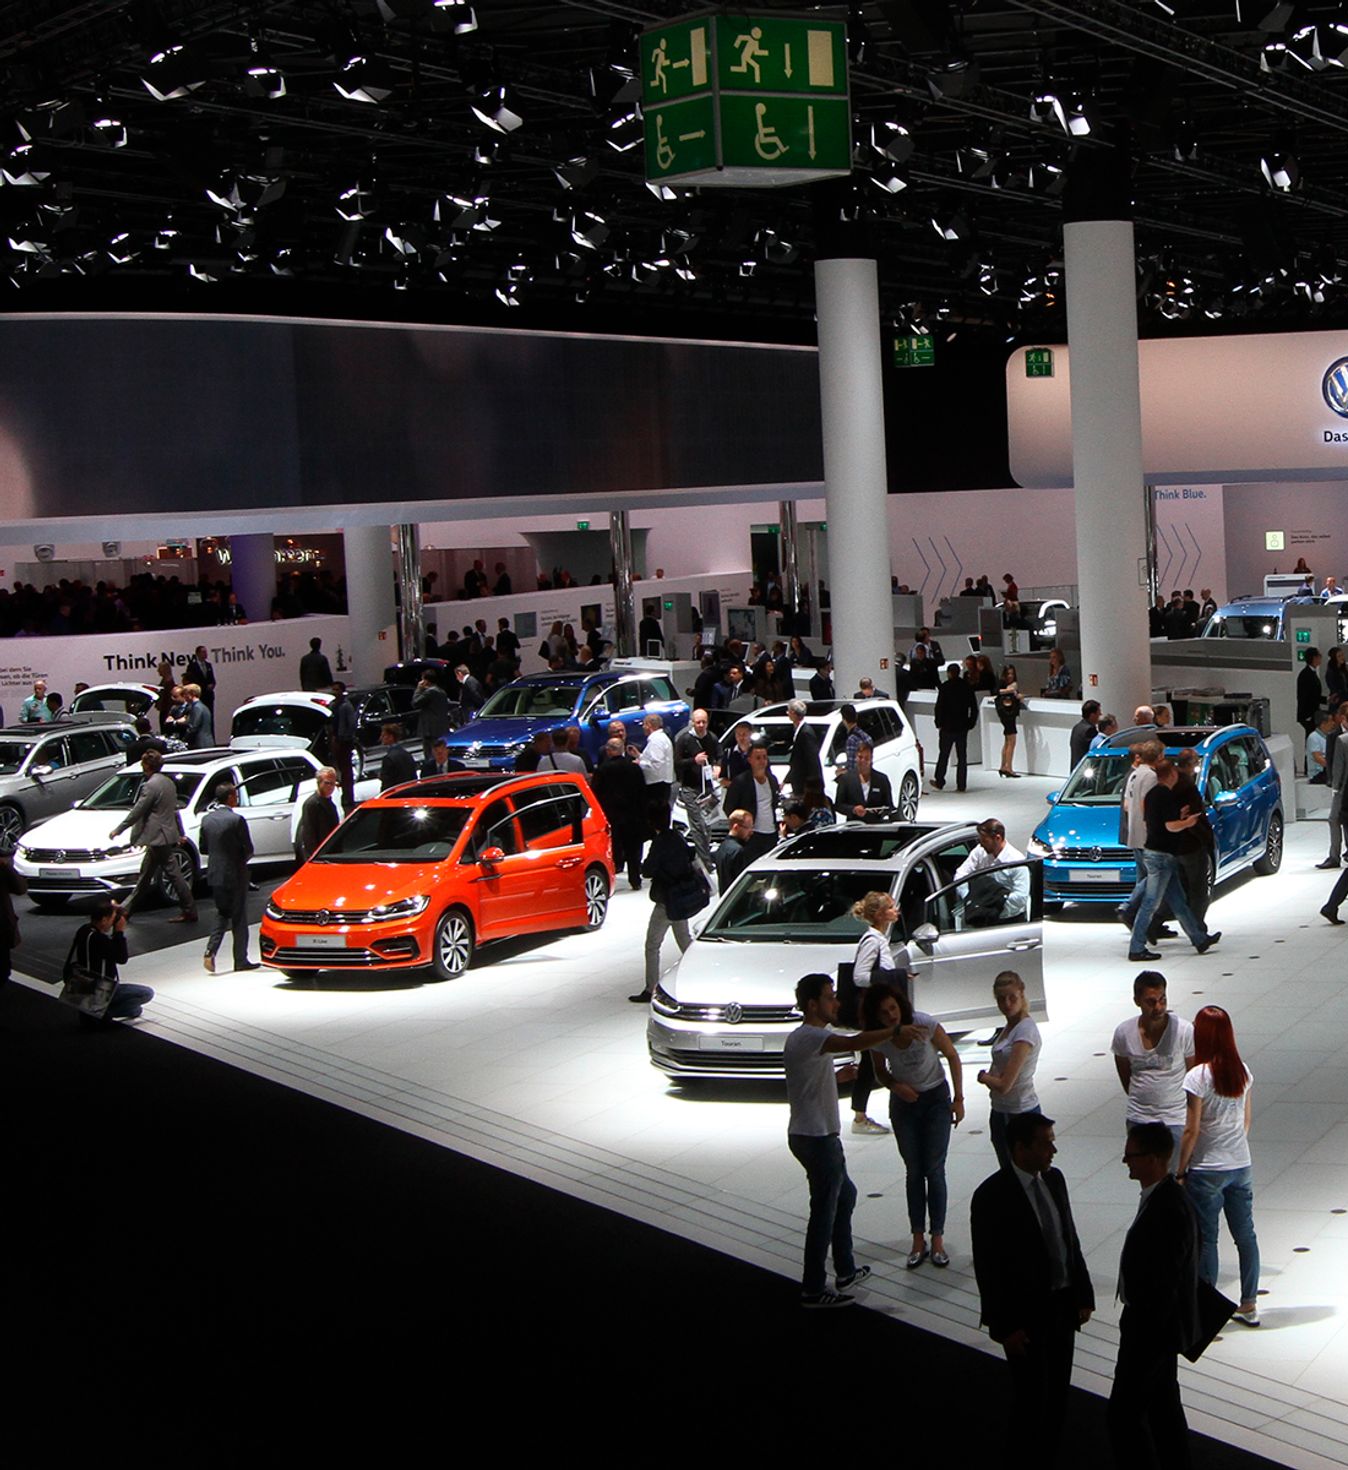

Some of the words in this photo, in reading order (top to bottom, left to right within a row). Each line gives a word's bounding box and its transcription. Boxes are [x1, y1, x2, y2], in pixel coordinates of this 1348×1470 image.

[1323, 430, 1348, 442] Das
[1155, 489, 1180, 500] Think
[1183, 489, 1207, 499] Blue.
[103, 653, 157, 671] Think
[210, 645, 255, 664] Think
[258, 643, 286, 659] You.
